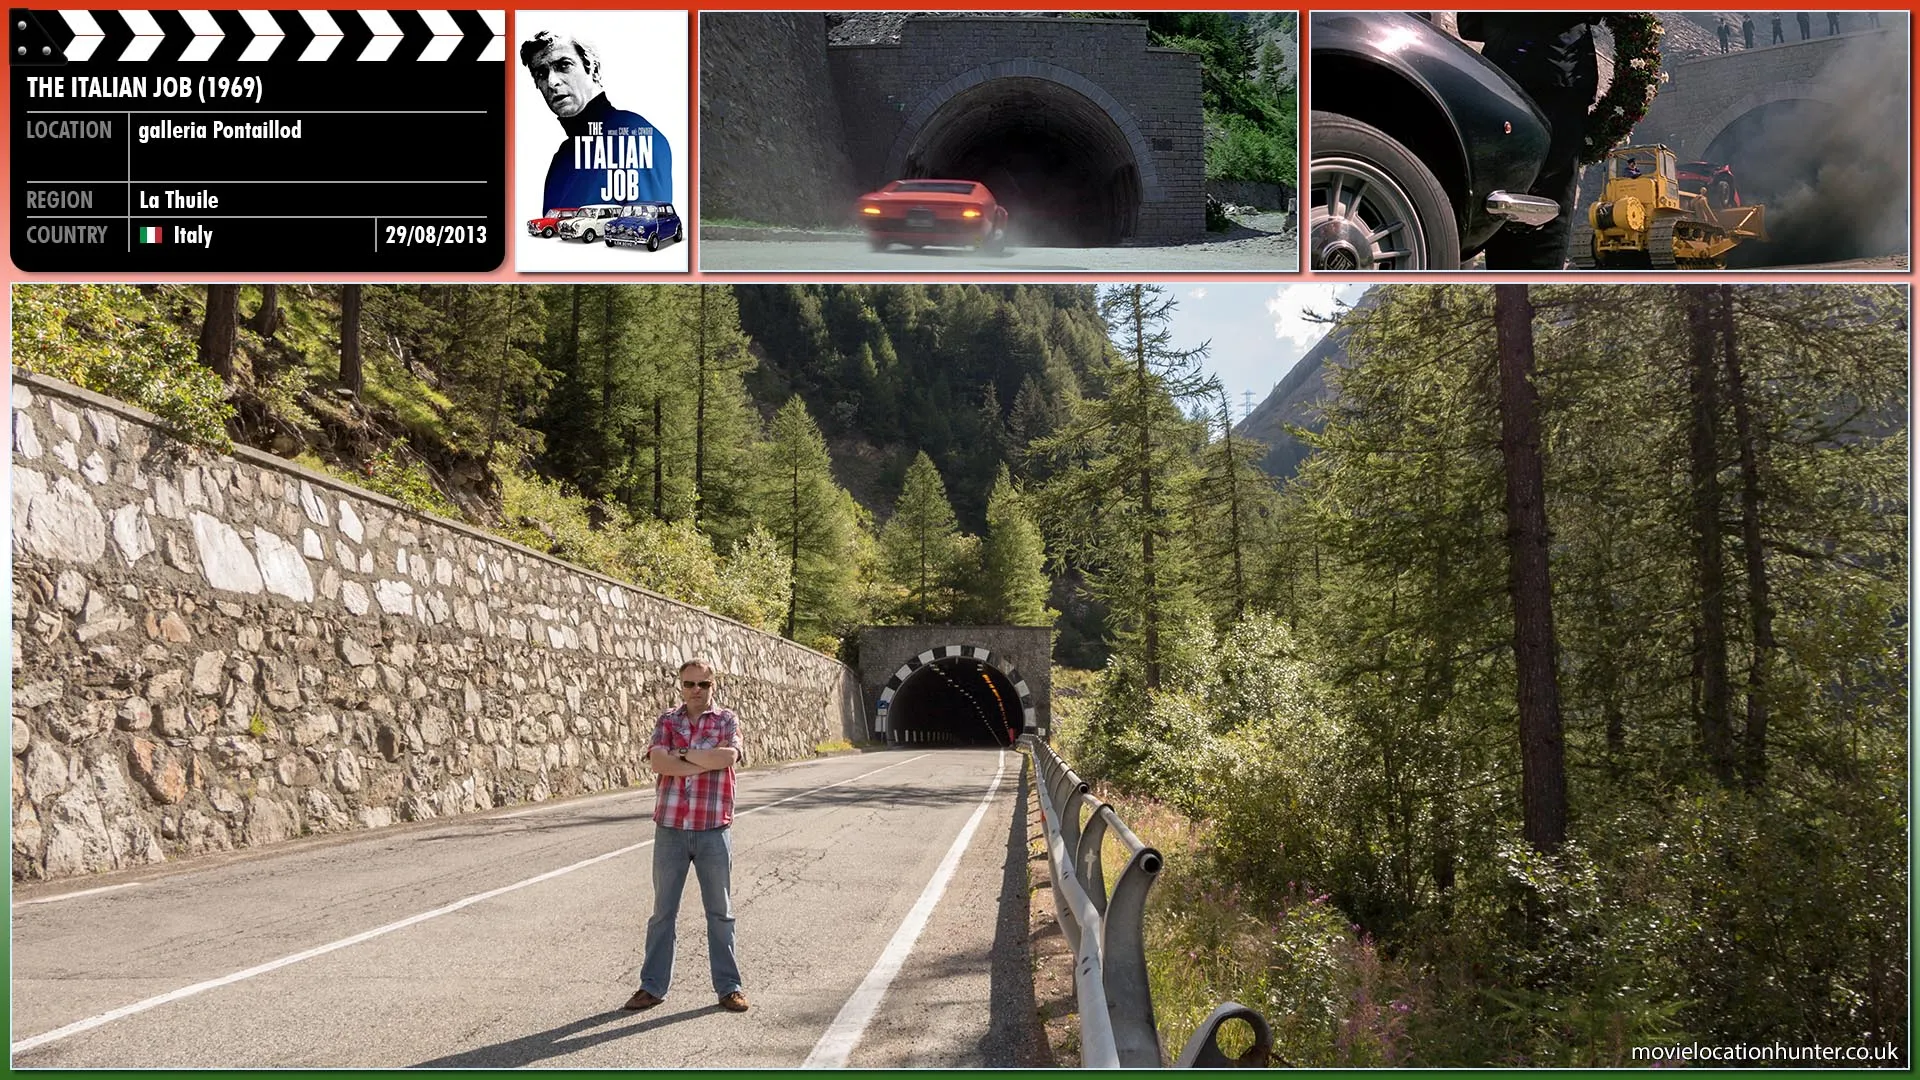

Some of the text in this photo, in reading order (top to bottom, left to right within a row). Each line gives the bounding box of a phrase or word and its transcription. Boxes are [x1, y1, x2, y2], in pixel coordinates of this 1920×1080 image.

[588, 122, 603, 135] THE
[575, 136, 653, 169] ITALIAN
[601, 169, 638, 201] JOB
